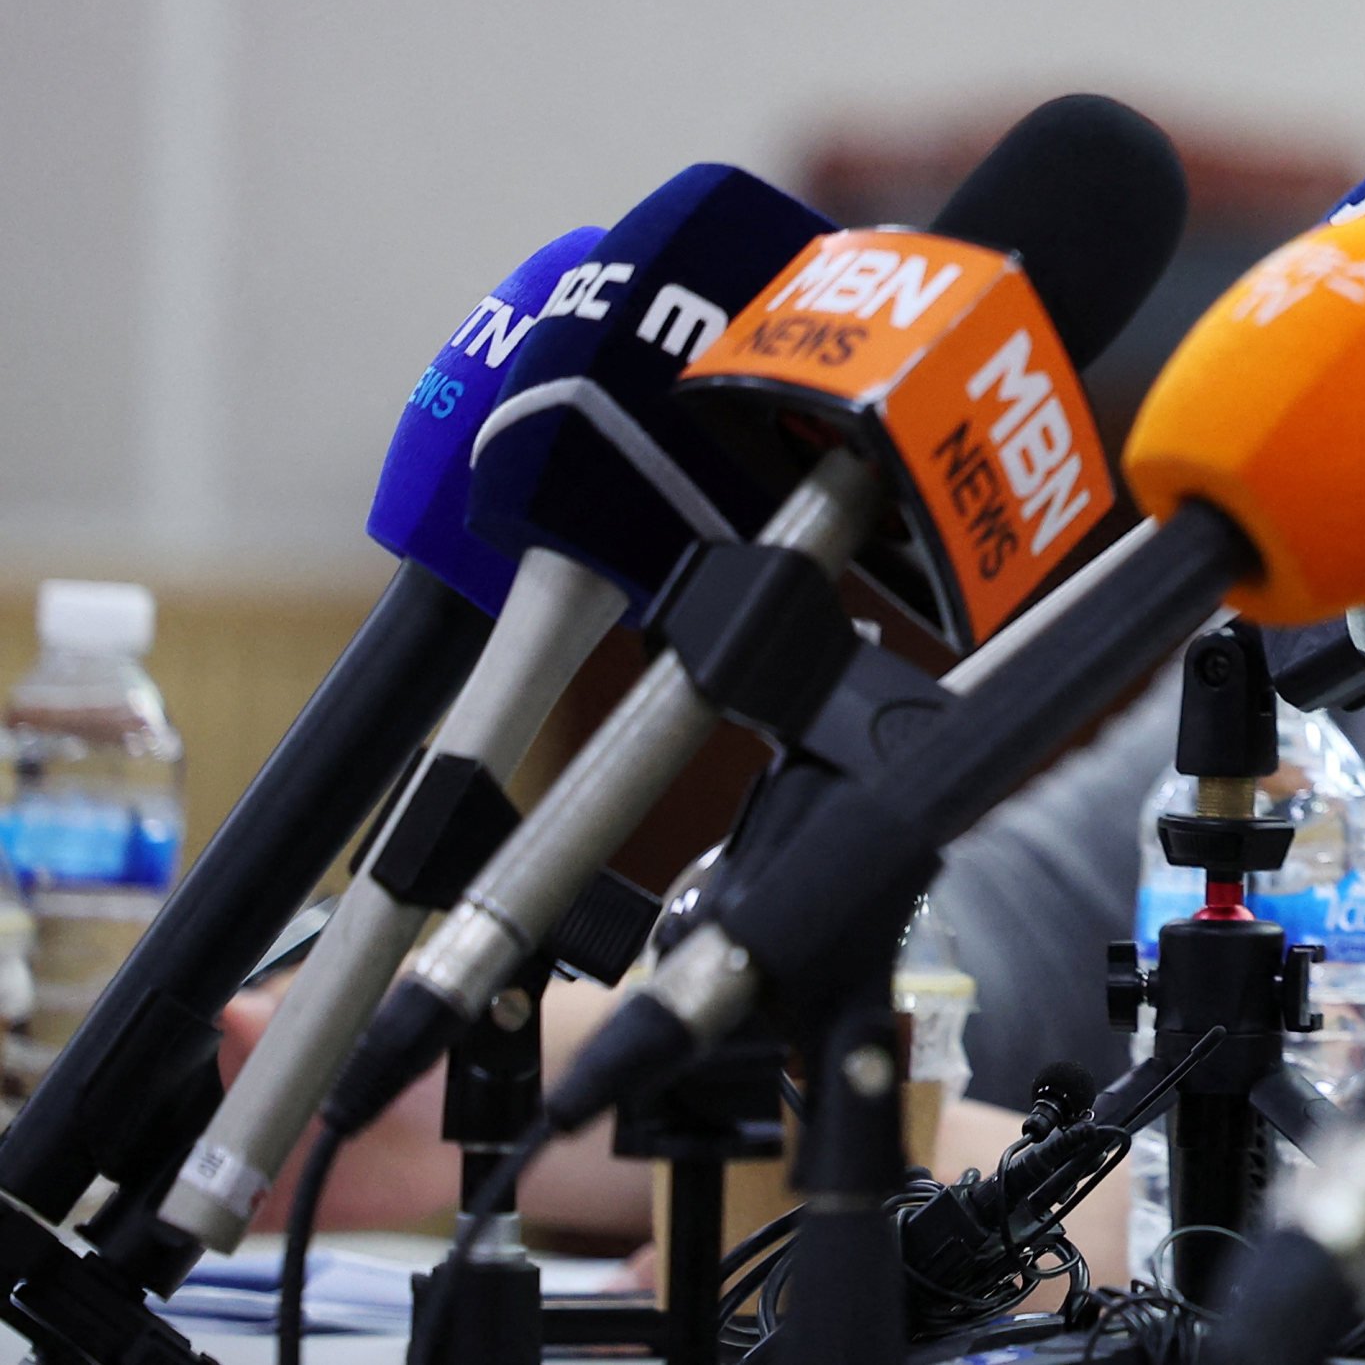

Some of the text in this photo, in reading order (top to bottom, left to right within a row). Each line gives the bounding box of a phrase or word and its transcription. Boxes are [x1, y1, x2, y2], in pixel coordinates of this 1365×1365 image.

[536, 261, 635, 321] BC
[766, 248, 963, 329] MBN
[450, 295, 537, 370] TN
[732, 315, 872, 368] NEWS
[408, 366, 465, 420] EWS
[966, 329, 1091, 557] MBN
[931, 421, 1020, 582] NEWS
